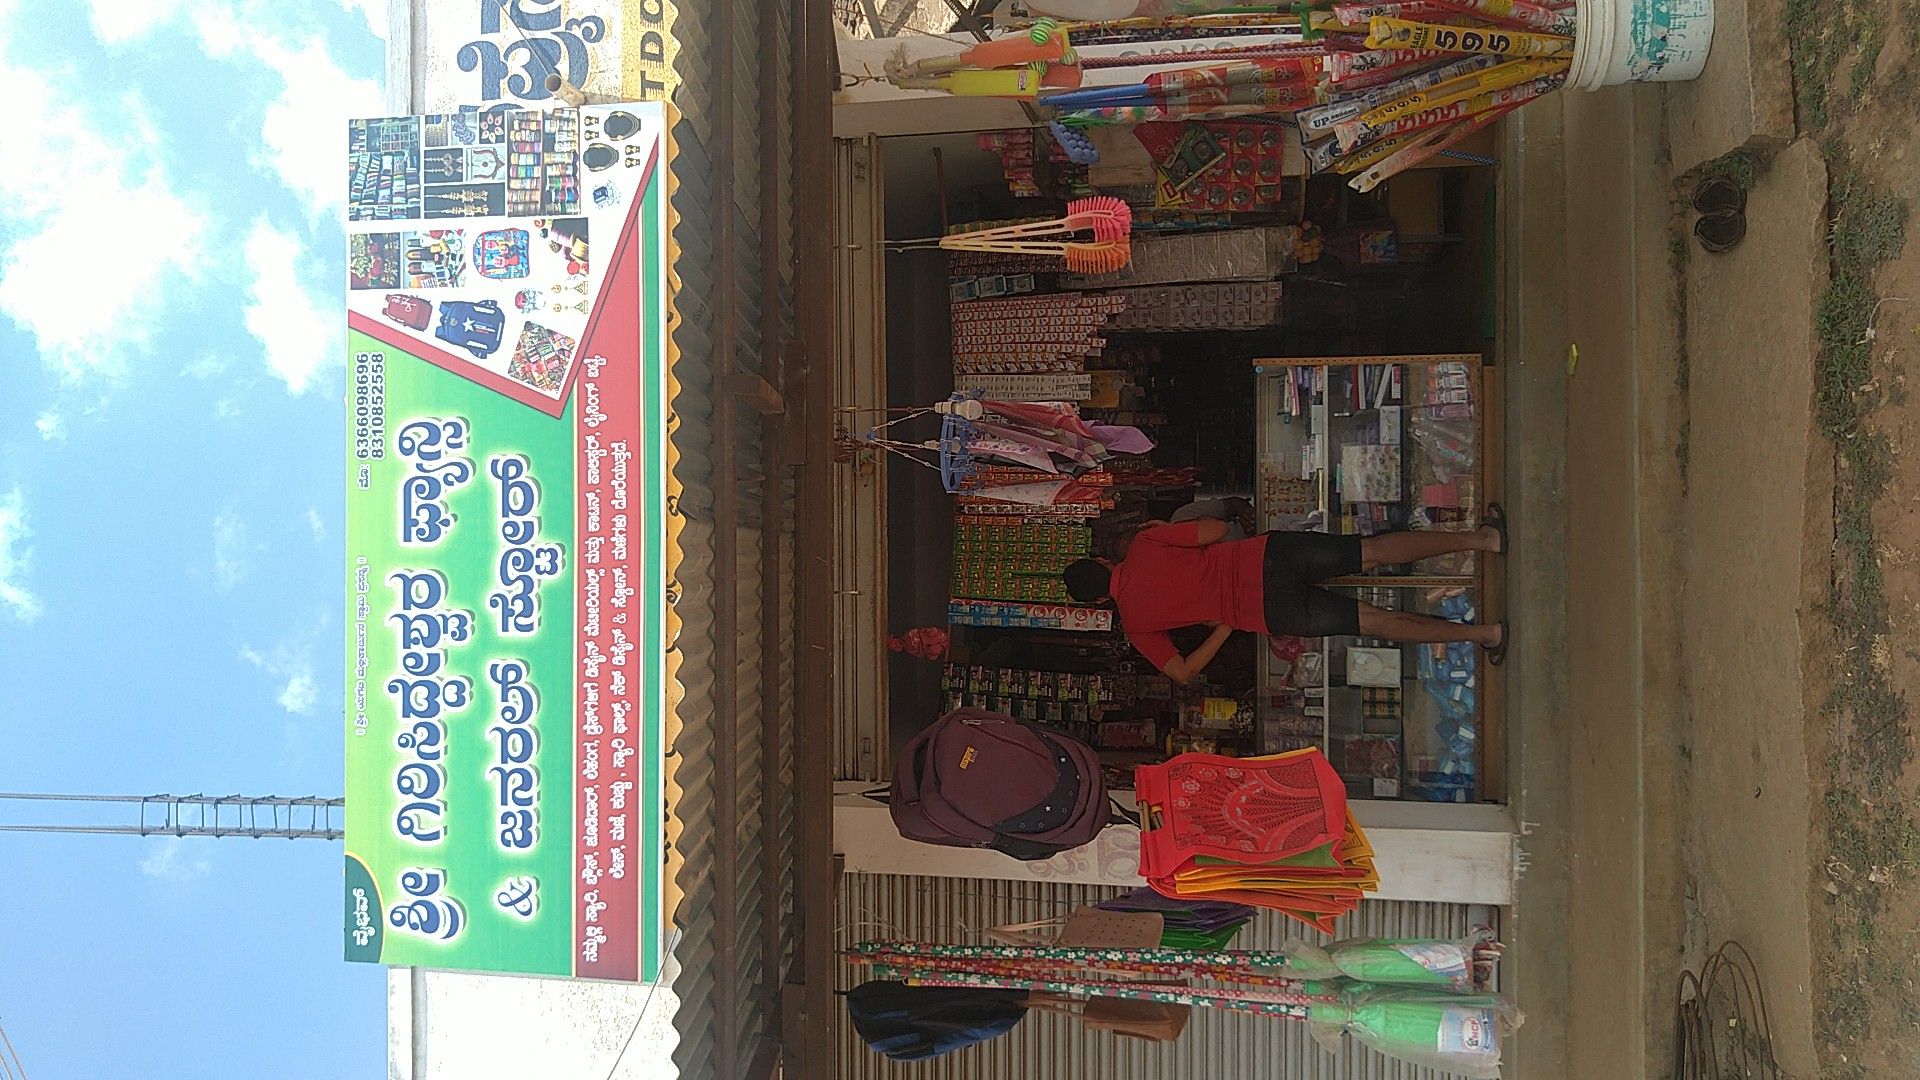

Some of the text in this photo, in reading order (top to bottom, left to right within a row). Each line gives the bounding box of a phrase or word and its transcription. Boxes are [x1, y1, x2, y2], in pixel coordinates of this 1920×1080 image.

[1434, 29, 1511, 53] 595
[356, 353, 369, 459] 6366098696
[371, 353, 384, 459] 8310852558
[584, 536, 605, 564] ಮತ್ತು
[612, 612, 627, 624] &
[387, 418, 469, 940] ಶ್ರೀ ಗಿರಿಸಿದ್ದೇಶ್ವರ ಫ್ಯಾನ್ಸಿ
[488, 457, 560, 917] & ಜನರಲ್ ಸ್ಟೋರ್
[582, 926, 607, 962] ನಮ್ಮಲ್ಲಿ
